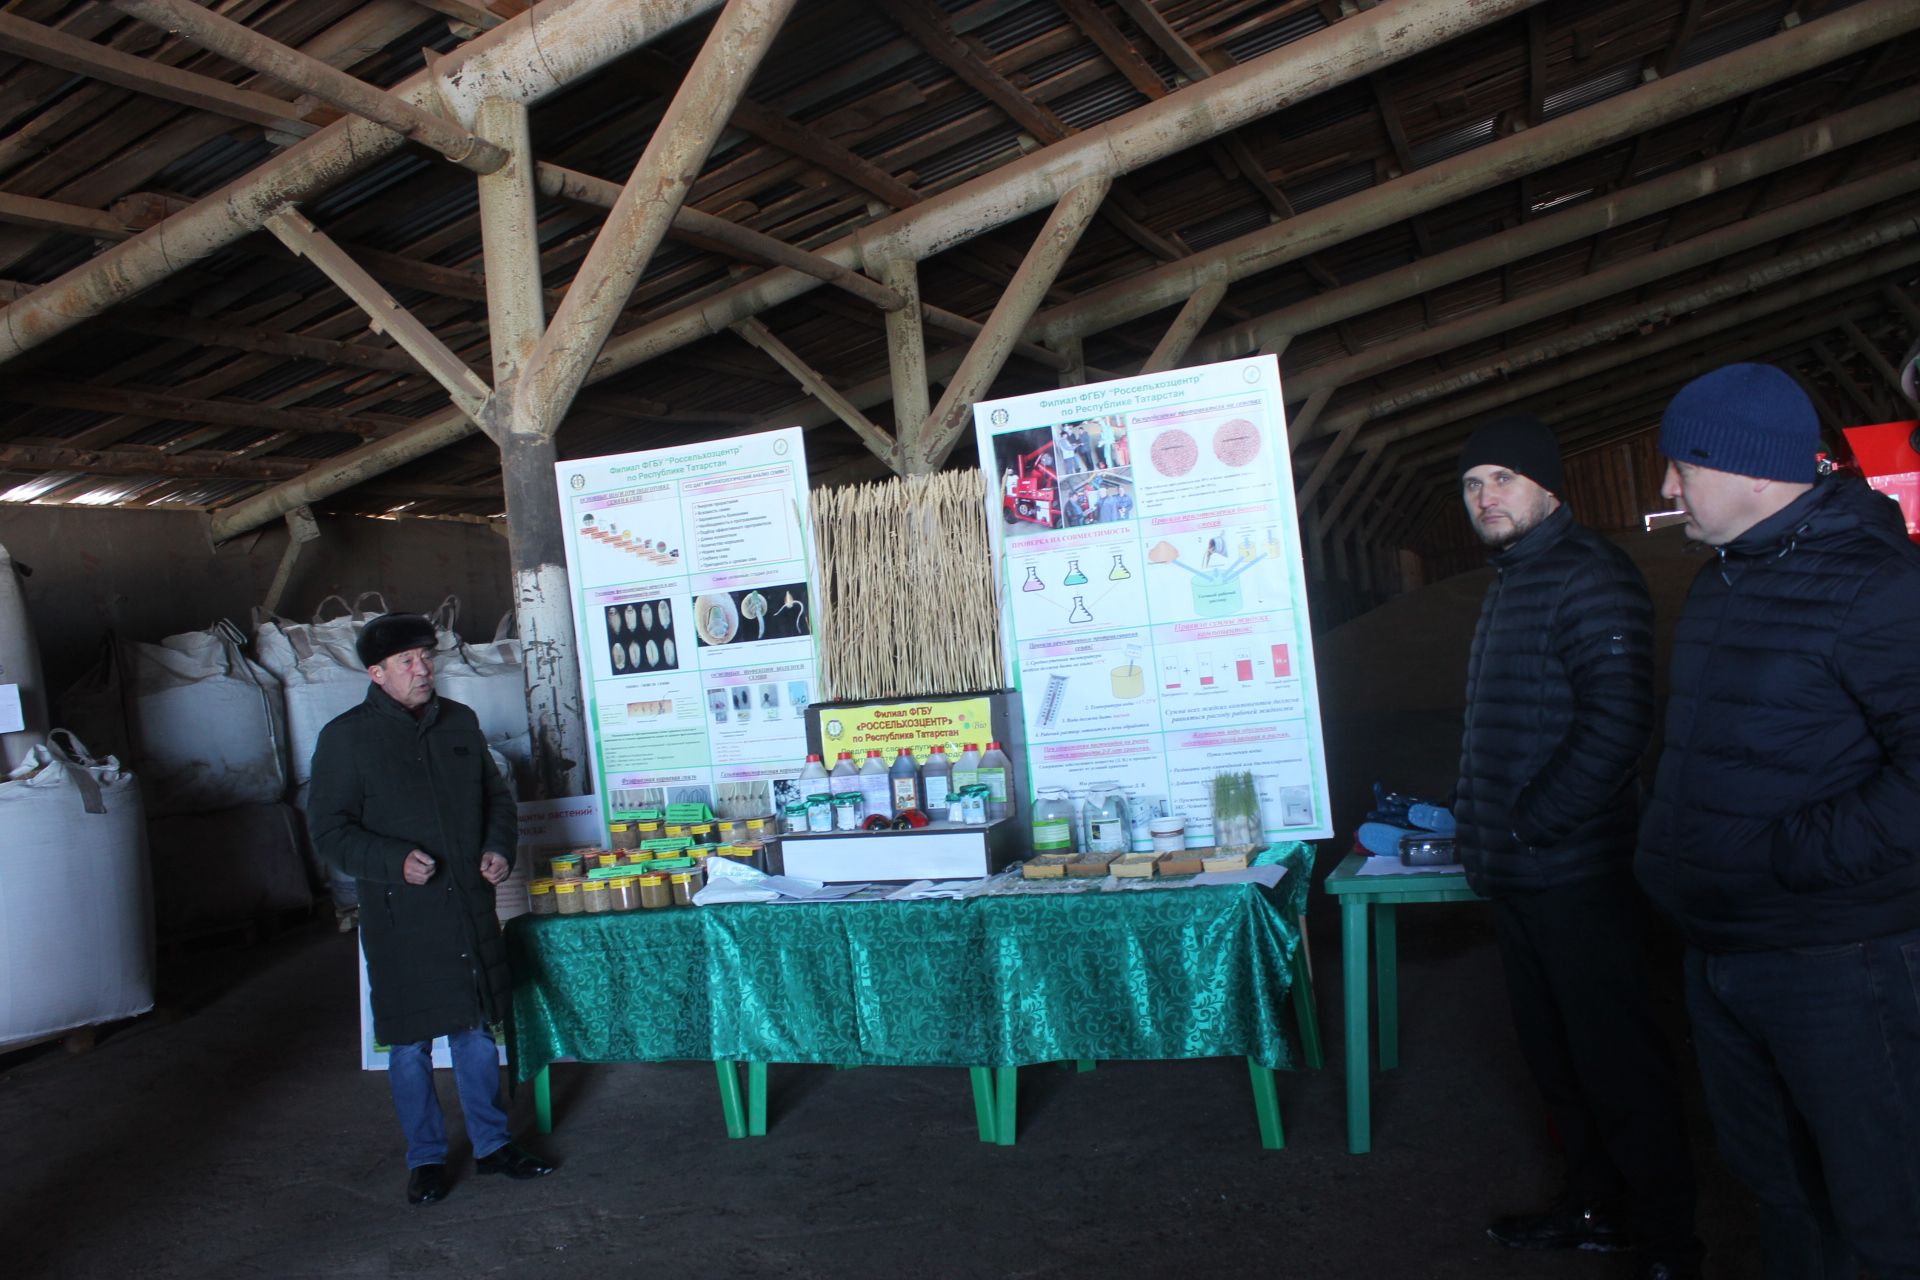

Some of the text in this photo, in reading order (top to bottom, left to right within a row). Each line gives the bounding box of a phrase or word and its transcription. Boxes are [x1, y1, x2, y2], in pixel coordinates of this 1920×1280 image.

[1039, 394, 1077, 408] Филиал
[1079, 390, 1105, 402] ФГБУ
[1061, 388, 1184, 416] по Республике Татарстан
[609, 462, 640, 475] Филиал
[641, 458, 663, 469] ФГБУ
[626, 458, 727, 482] по Республике Татарстан
[1011, 537, 1048, 548] ПРОВЕРКА
[1061, 526, 1130, 542] СОВМЕСТИМОСТЬ
[874, 707, 933, 718] Филиал ФГБУ
[856, 717, 953, 731] «РОССЕЛЬХОЗЦЕНТР»
[852, 729, 959, 743] по Республике Татарстан
[518, 806, 593, 822] щиты растений
